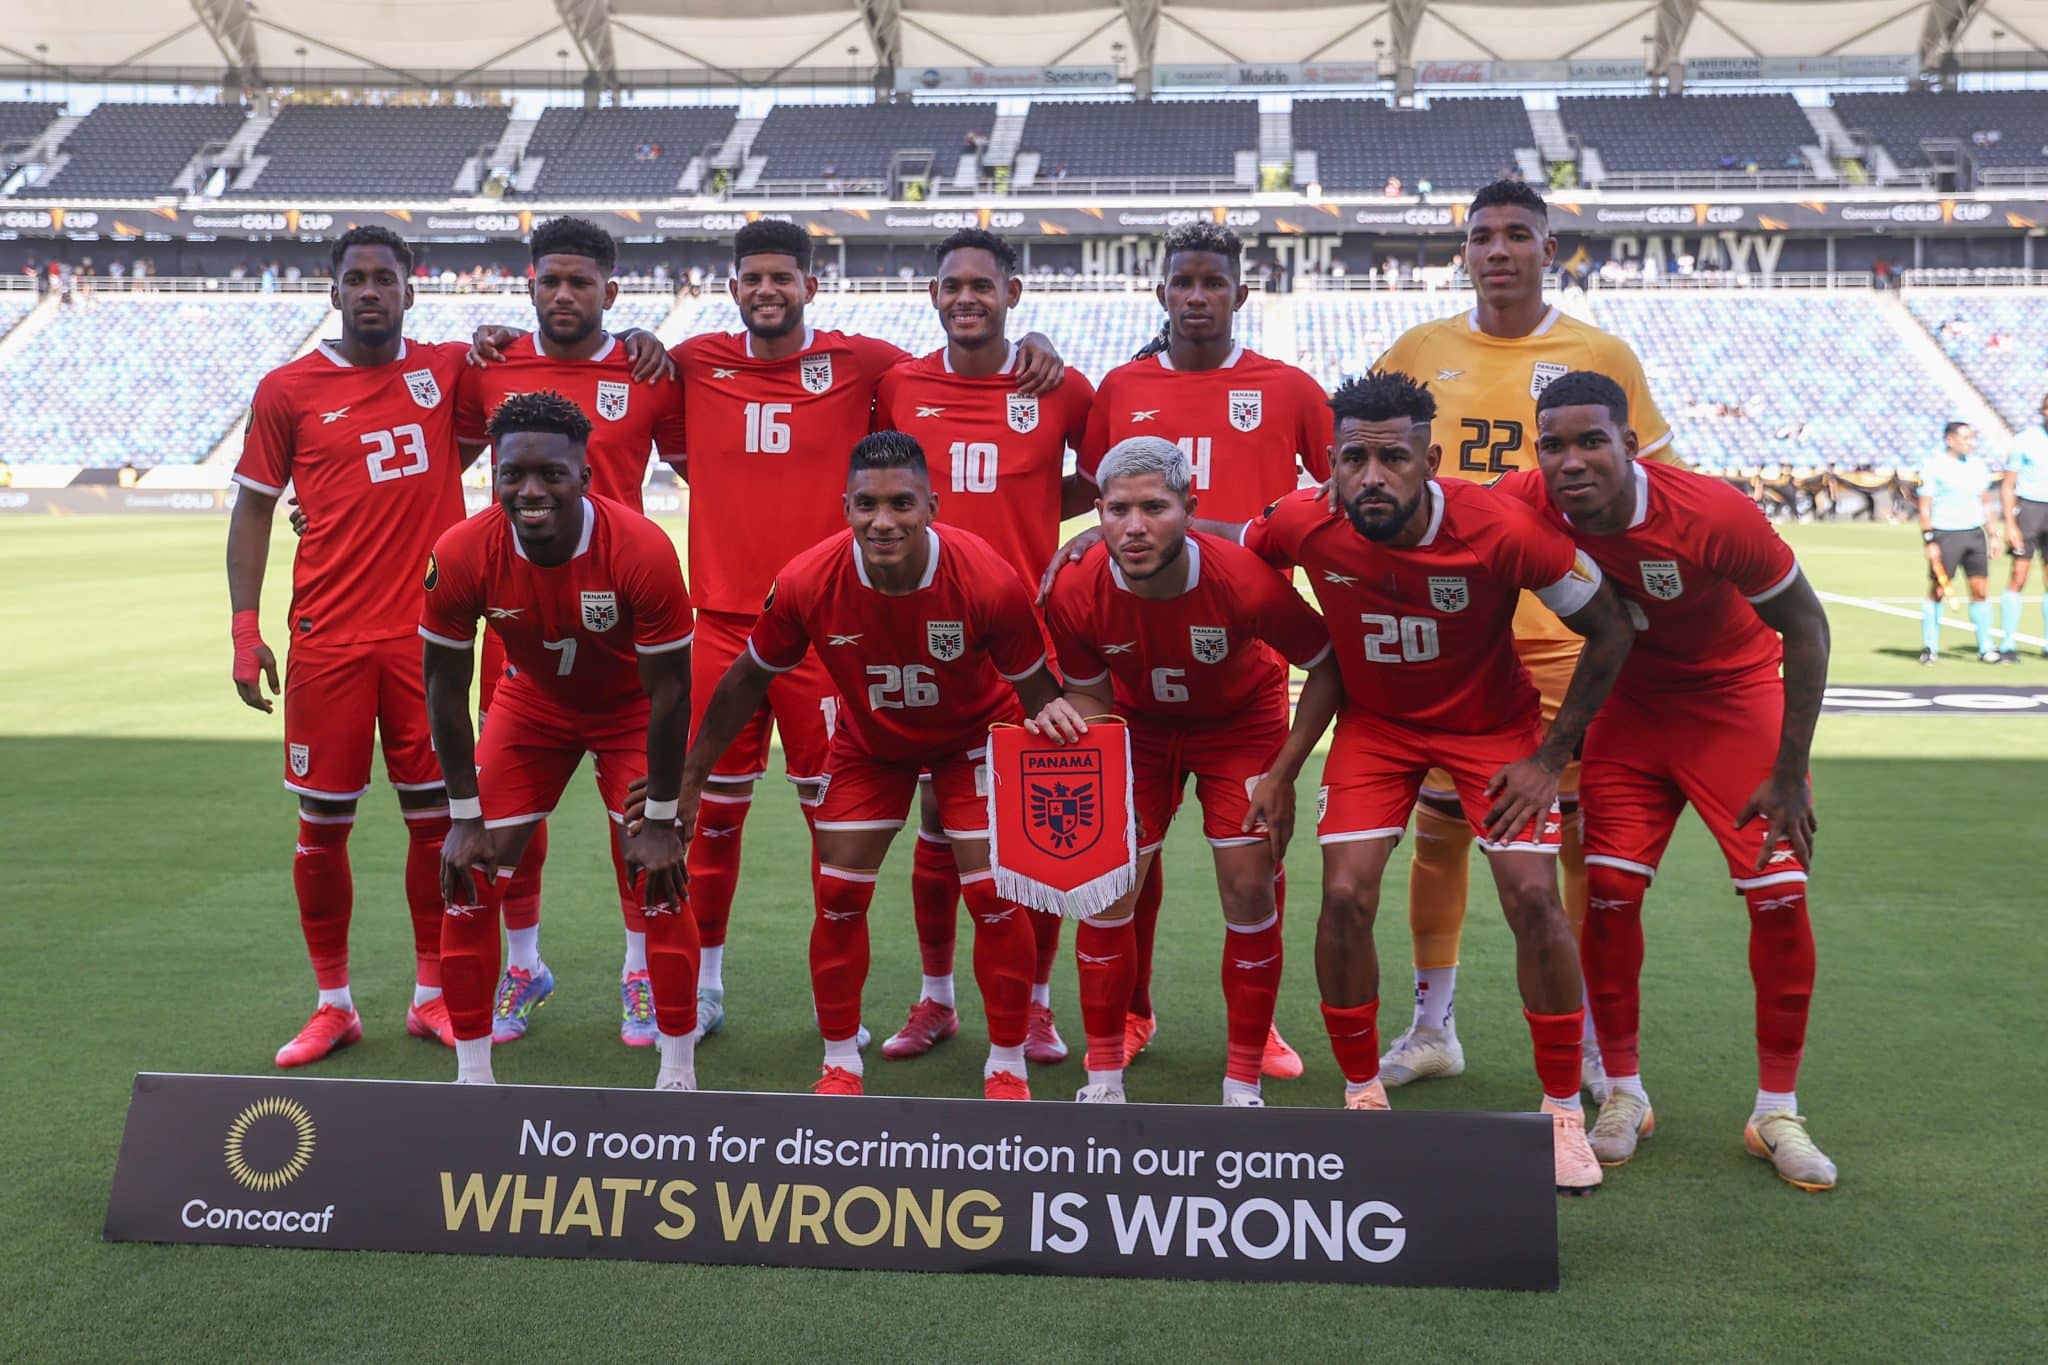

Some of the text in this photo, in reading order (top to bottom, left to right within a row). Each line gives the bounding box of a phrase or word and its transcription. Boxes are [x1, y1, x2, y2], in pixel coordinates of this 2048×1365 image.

[1043, 70, 1113, 84] Spectrum
[5, 212, 98, 227] GOLD CUP
[241, 213, 286, 229] GOLD
[298, 213, 333, 230] CUP
[474, 214, 519, 230] GOLD
[702, 213, 747, 229] GOLD
[932, 211, 978, 228] GOLD
[990, 211, 1024, 228] CUP
[1225, 209, 1260, 226] CUP
[1404, 208, 1452, 225] GOLD
[1645, 207, 1695, 223] GOLD
[1707, 206, 1744, 222] CUP
[1891, 204, 1942, 221] GOLD
[1952, 205, 1992, 221] CUP
[744, 402, 792, 454] 16
[1460, 417, 1523, 473] 22
[360, 423, 429, 484] 23
[949, 442, 999, 493] 10
[1361, 613, 1440, 663] 20
[543, 637, 578, 676] 7
[866, 664, 940, 711] 26
[1151, 667, 1189, 702] 6
[519, 1119, 1345, 1189] No room for discrimination in our game
[181, 1199, 335, 1233] Concacaf
[440, 1171, 1406, 1263] WHAT'S WRONG IS WRONG
